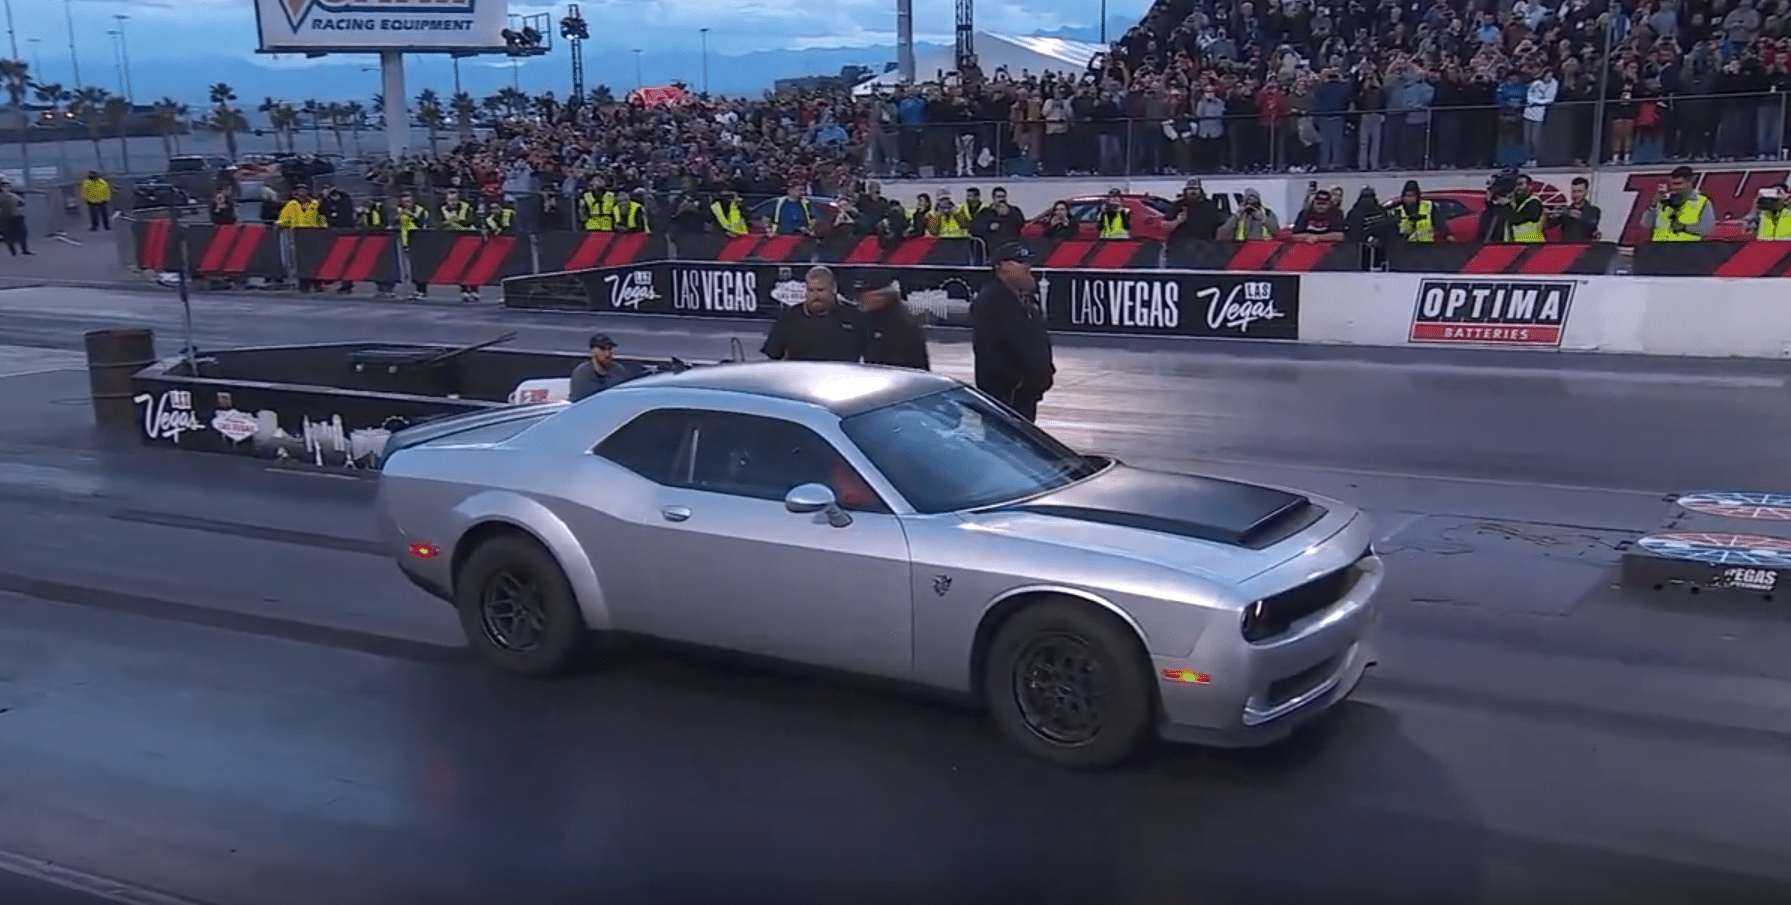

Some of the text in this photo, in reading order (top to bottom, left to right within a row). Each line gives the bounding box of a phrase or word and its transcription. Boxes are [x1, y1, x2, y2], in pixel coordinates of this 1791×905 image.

[311, 18, 474, 31] RACING EQUIPMENT
[604, 272, 662, 309] Vegas
[672, 269, 699, 310] LAS
[701, 270, 757, 312] VEGAS
[1071, 279, 1179, 328] LAS VEGAS
[1197, 284, 1285, 331] Vegas
[1246, 283, 1270, 299] LAS
[1423, 288, 1560, 321] OPTIMA
[1444, 327, 1529, 341] BATTERIES
[134, 393, 206, 443] Vegas
